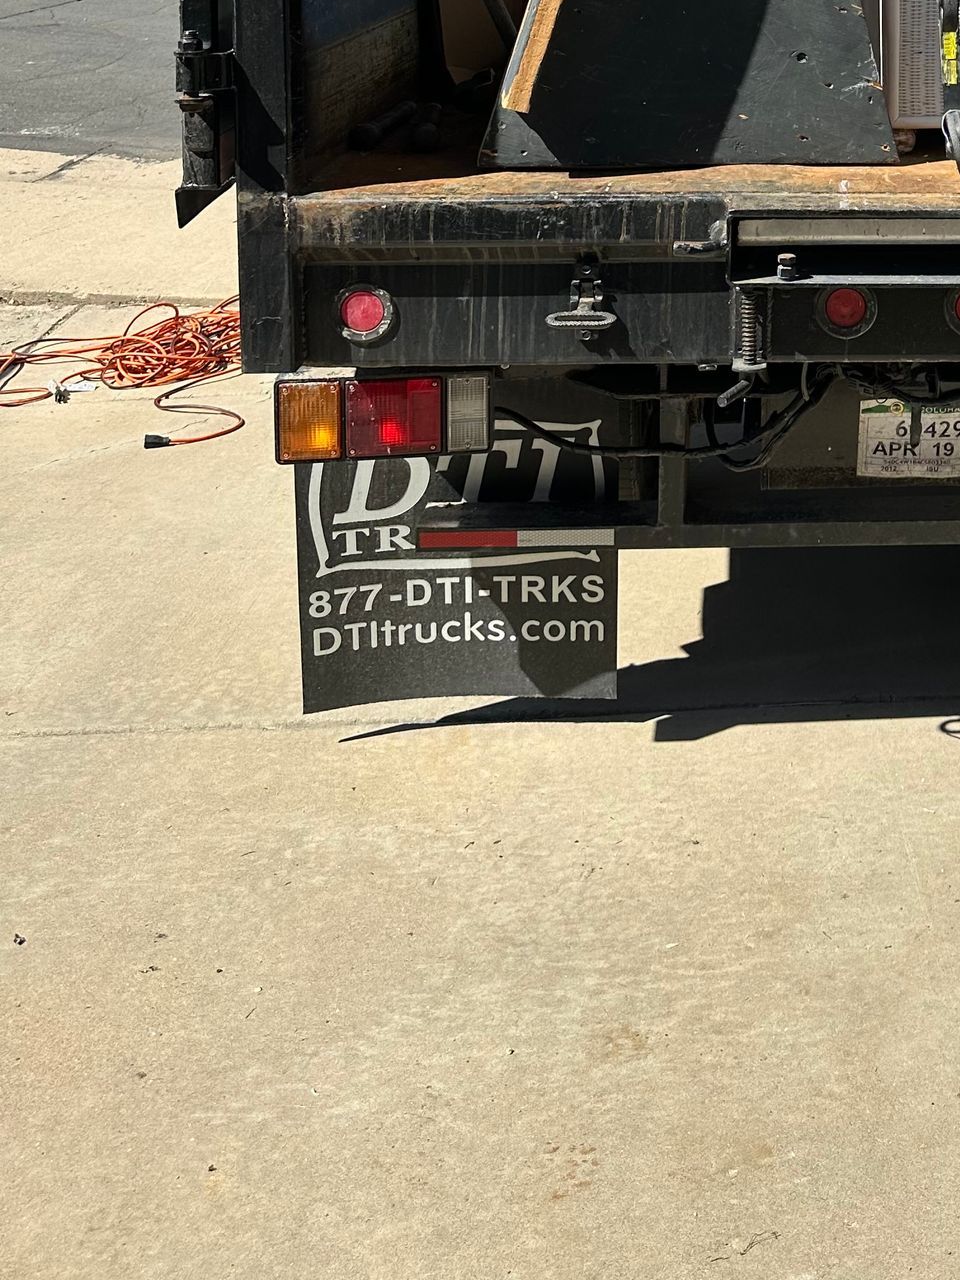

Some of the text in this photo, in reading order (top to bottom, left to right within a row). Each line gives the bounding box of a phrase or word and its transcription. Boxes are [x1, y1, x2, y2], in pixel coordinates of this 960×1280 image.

[872, 441, 920, 457] APR
[932, 442, 955, 457] 19
[308, 575, 605, 618] 877-DTI-TRKS
[313, 612, 605, 656] DTItrucks.com
